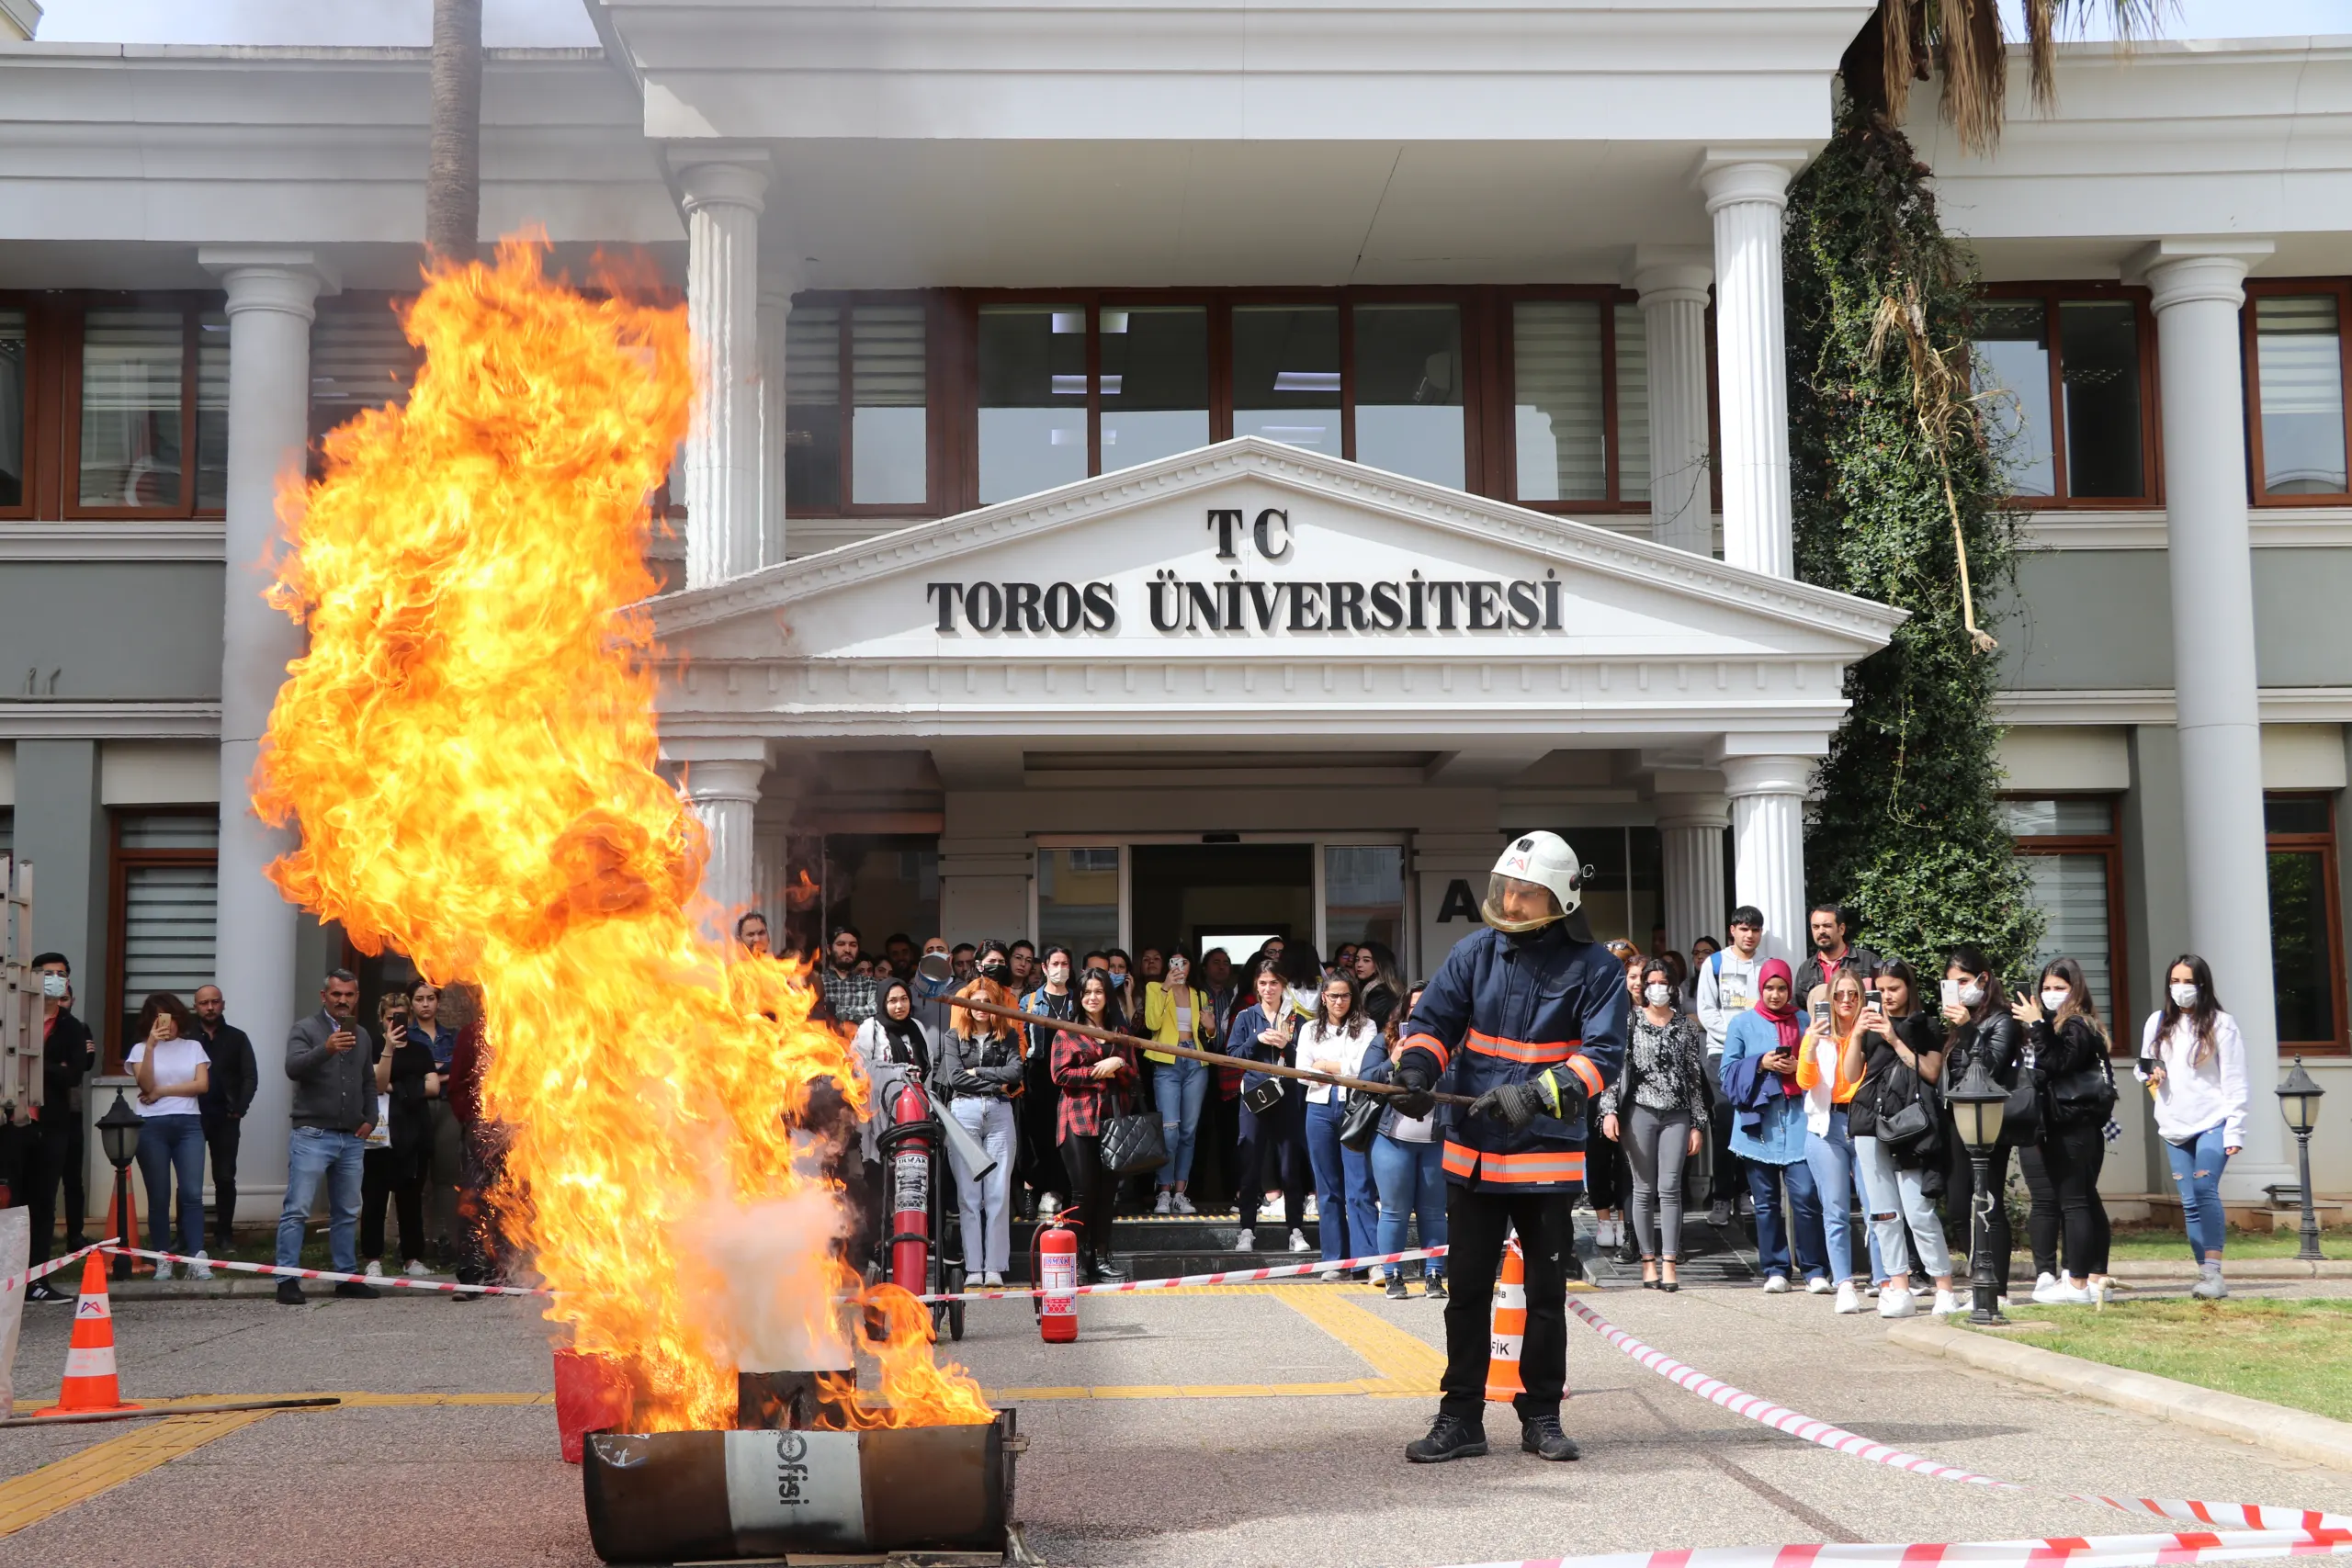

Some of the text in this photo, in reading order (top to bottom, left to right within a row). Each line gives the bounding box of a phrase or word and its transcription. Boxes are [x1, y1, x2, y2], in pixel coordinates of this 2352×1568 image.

[927, 569, 1563, 632] TOROS ÜNİVERSİTESİ
[776, 1433, 810, 1506] Ofisi
